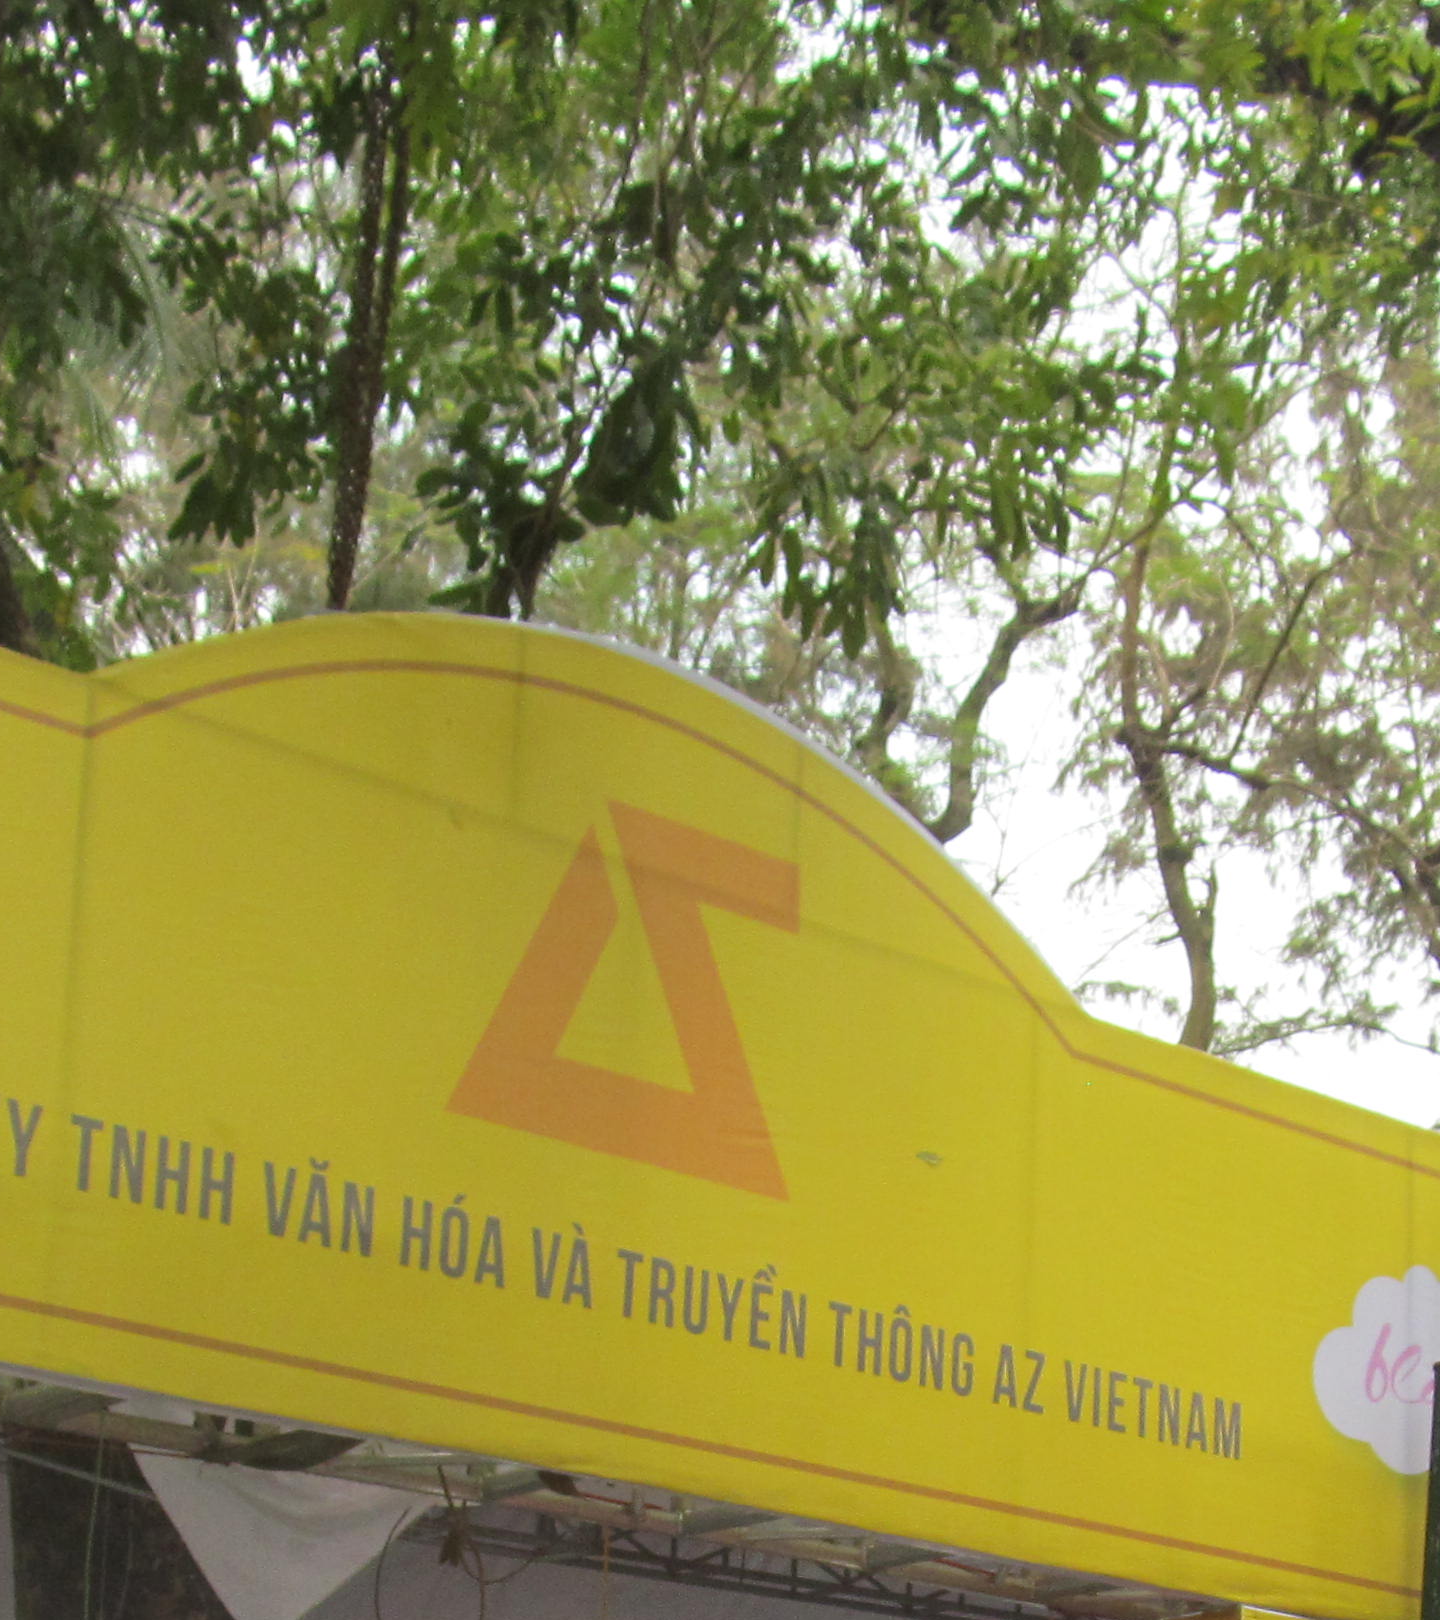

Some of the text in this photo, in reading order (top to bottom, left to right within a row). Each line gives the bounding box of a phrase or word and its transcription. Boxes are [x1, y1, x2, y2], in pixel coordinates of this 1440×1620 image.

[70, 1112, 236, 1225] TNHH
[263, 1156, 376, 1259] VĂN
[399, 1193, 506, 1290] HÓA
[531, 1221, 593, 1310] VÀ
[617, 1263, 808, 1359] TRUYỀN
[828, 1303, 975, 1398] THÔNG
[992, 1343, 1047, 1415] AZ
[1064, 1359, 1242, 1461] VIETNAM
